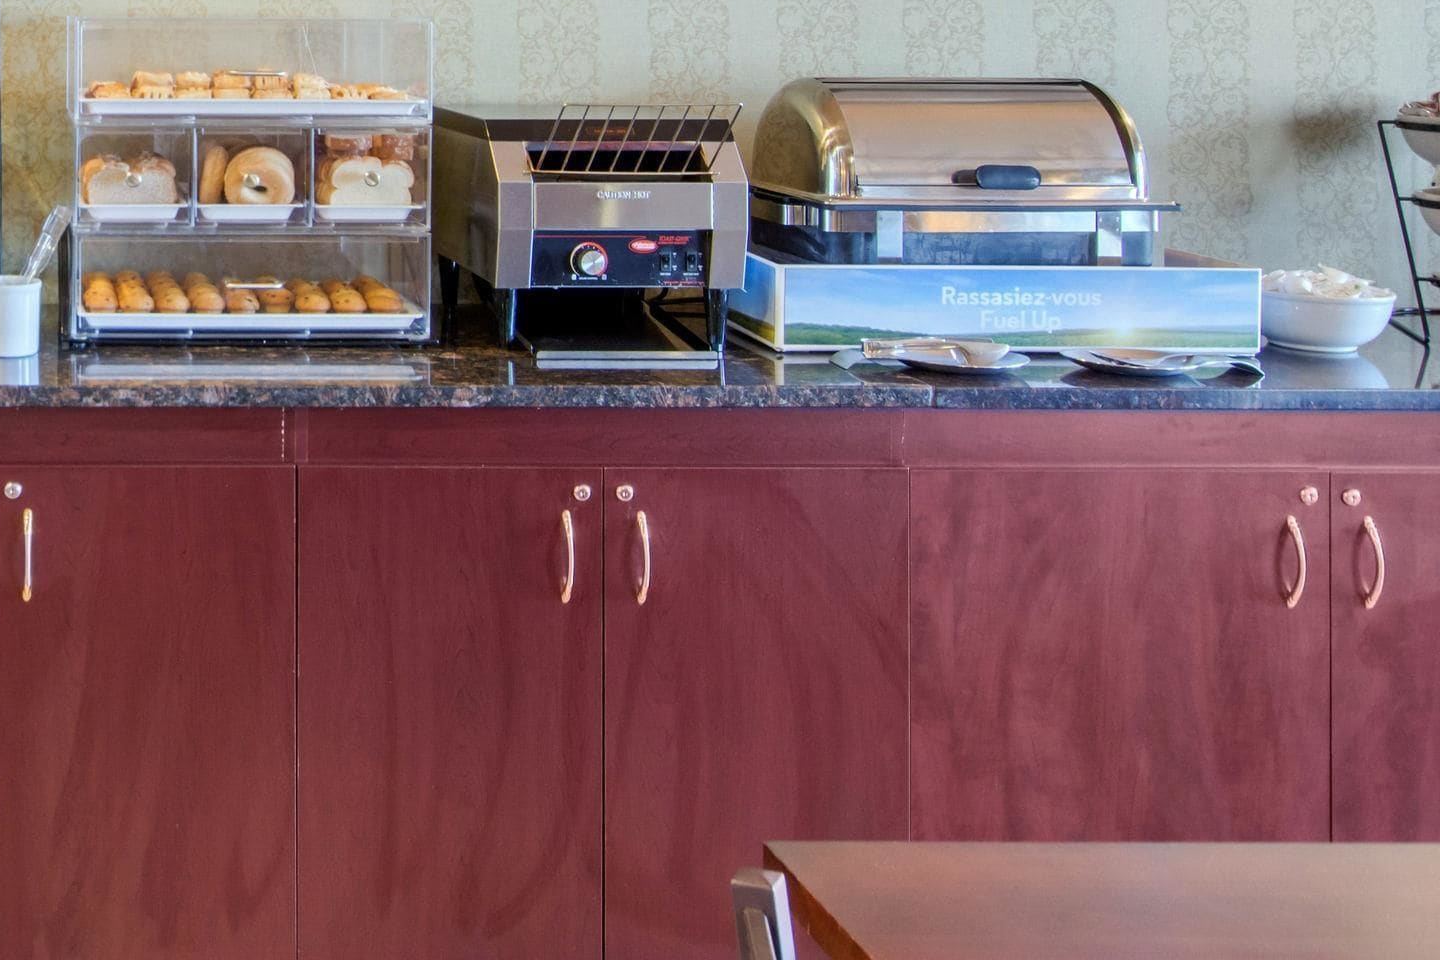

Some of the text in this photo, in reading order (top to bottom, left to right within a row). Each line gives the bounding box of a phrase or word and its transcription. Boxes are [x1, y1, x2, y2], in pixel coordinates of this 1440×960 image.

[633, 190, 651, 200] HOT
[941, 286, 1102, 306] Rassasiez-vous
[980, 310, 1062, 334] Fuel Up
